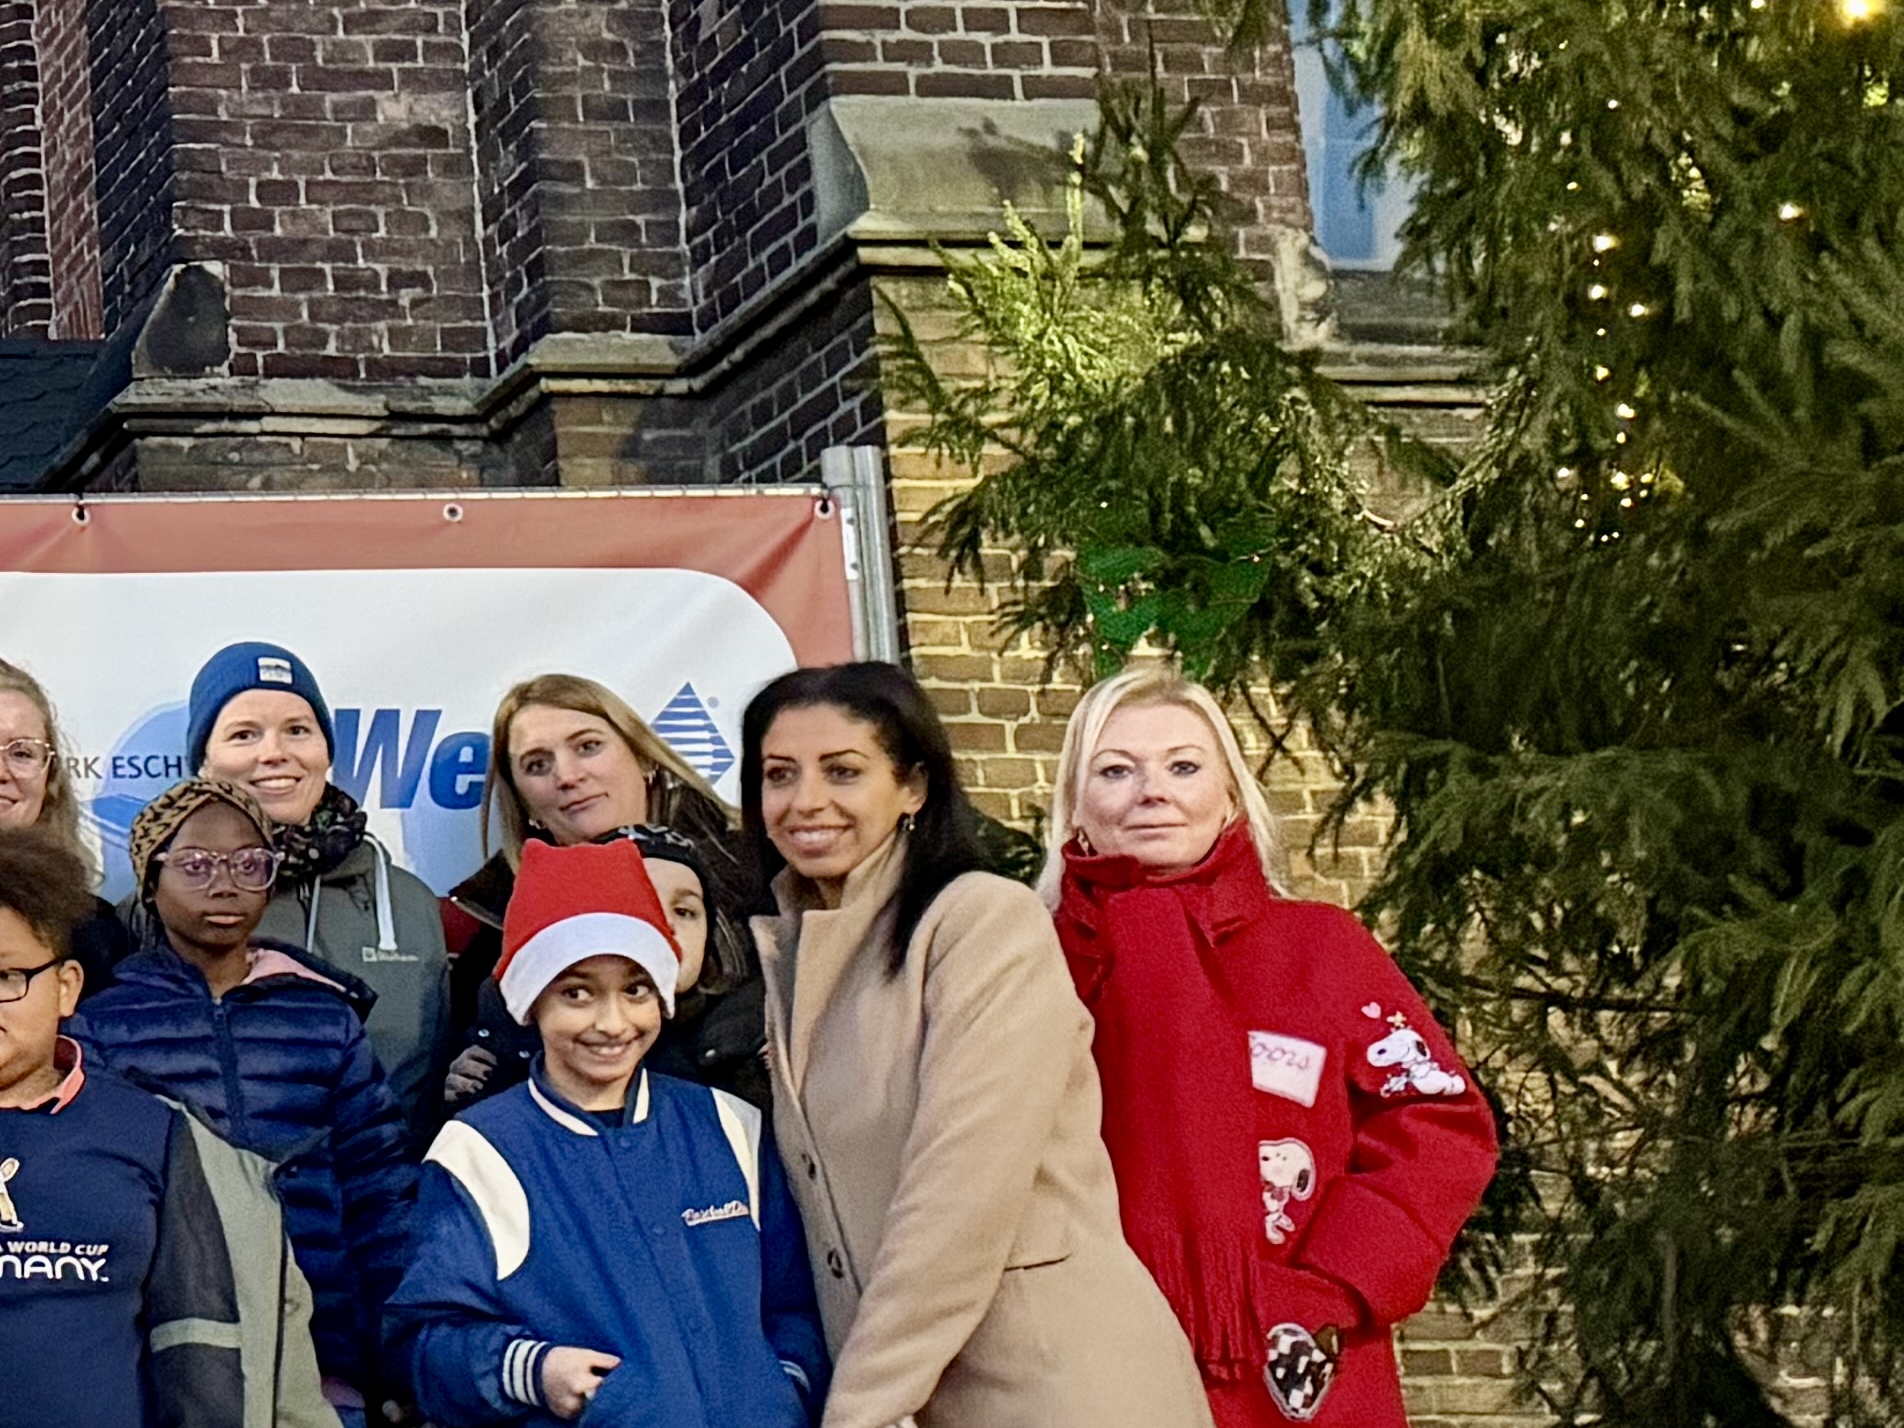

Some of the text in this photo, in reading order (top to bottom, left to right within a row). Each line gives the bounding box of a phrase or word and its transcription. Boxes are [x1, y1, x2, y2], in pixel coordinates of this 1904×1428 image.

[111, 755, 183, 780] ESCH
[332, 708, 491, 810] We
[6, 1240, 71, 1254] WORLD
[74, 1244, 110, 1256] CUP
